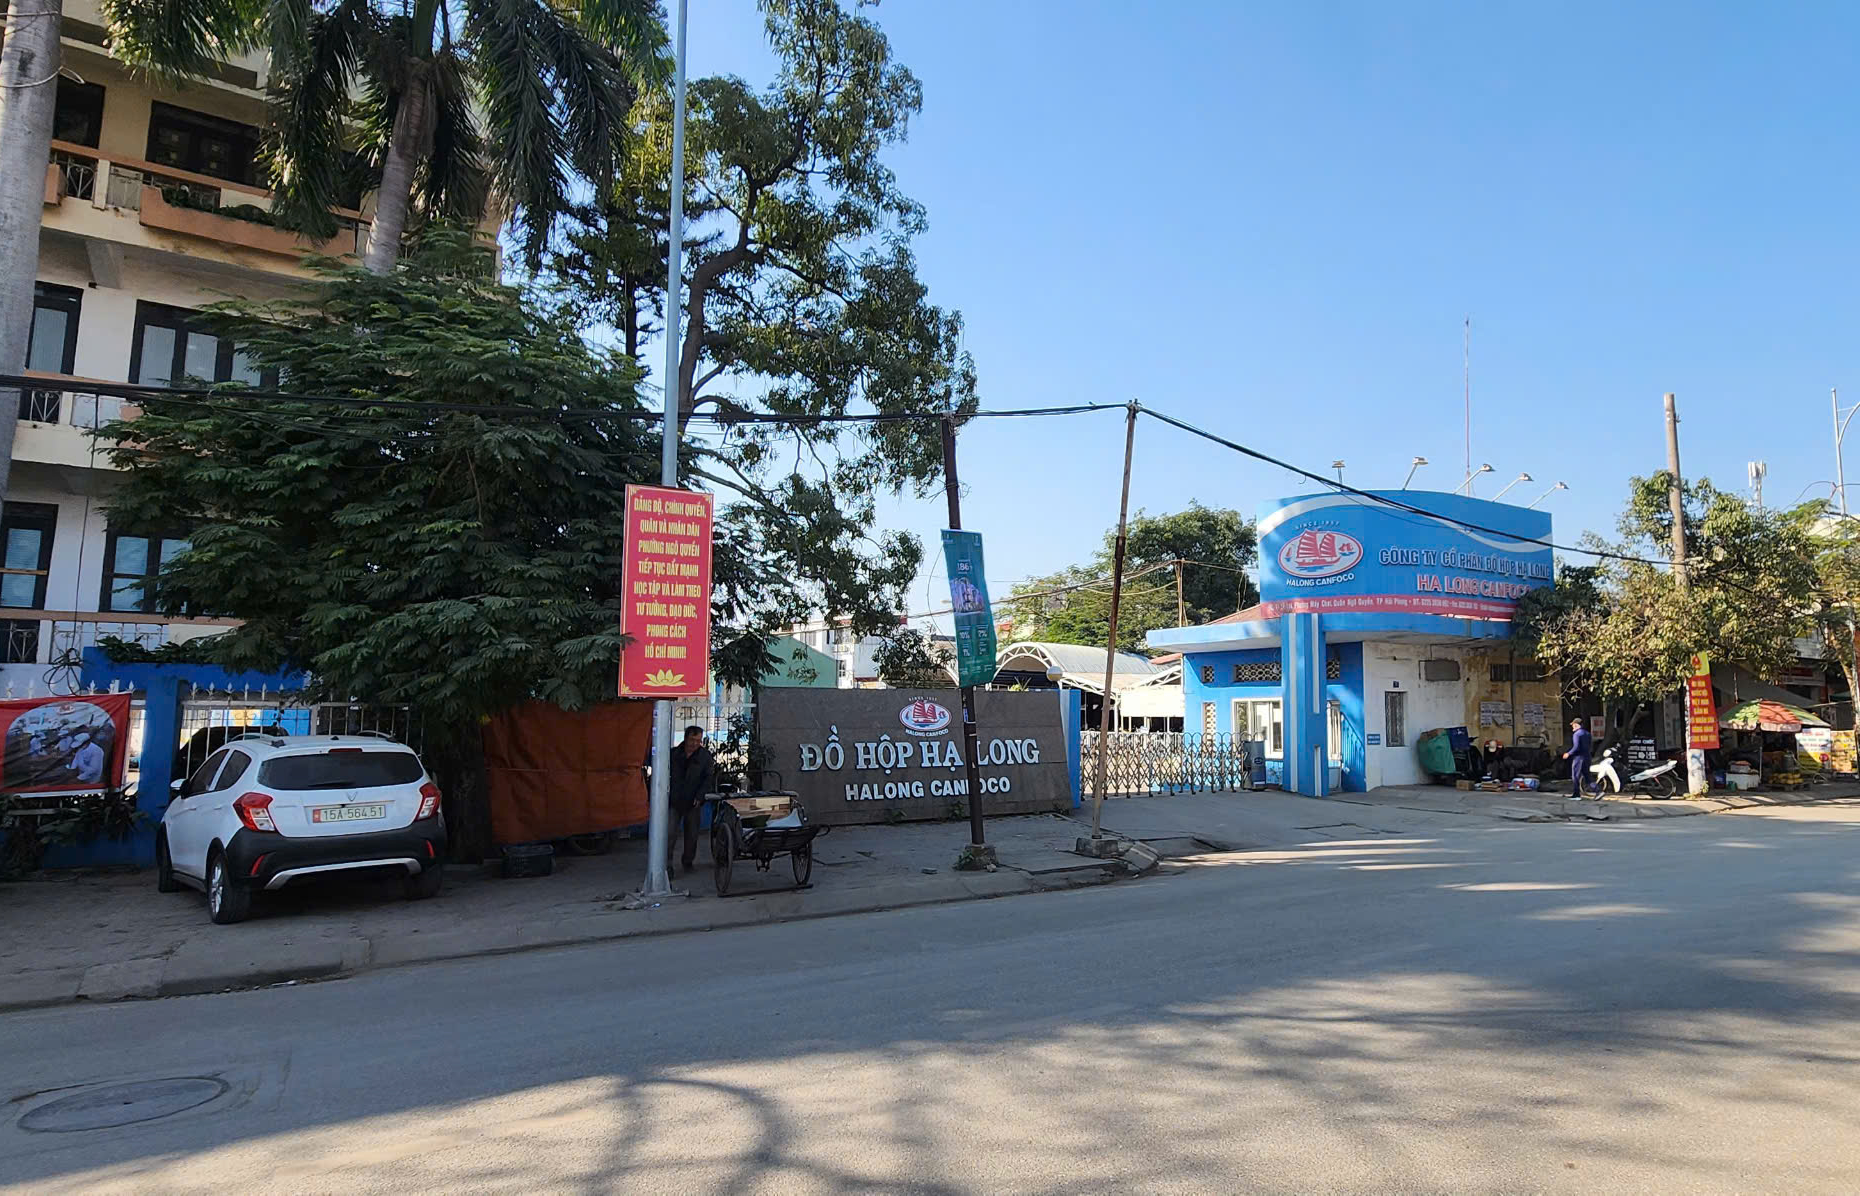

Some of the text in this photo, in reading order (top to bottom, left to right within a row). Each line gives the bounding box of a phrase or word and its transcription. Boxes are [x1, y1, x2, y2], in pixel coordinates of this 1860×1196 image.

[653, 498, 664, 516] BỘ,
[665, 500, 684, 515] CHÍNH
[685, 501, 707, 519] QUYỀN,
[640, 518, 700, 537] QUÂN VÀ NHÂN DÂN
[638, 538, 664, 555] PHƯỜNG
[680, 541, 700, 557] QUYỀN
[638, 557, 652, 574] TIẾP
[653, 561, 666, 577] TỤC
[680, 564, 699, 579] MẠNH
[1378, 545, 1420, 566] CÔNG
[1421, 549, 1439, 566] TY
[1440, 546, 1457, 567] CỔ
[1459, 550, 1483, 571] PHẦN
[1485, 553, 1498, 572] ĐỒ
[1499, 557, 1515, 578] HỘP
[634, 580, 702, 598] HỌC TẬP VÀ LÀM THEO
[1286, 573, 1355, 587] HALONG CANFOCO
[1445, 575, 1478, 595] LONG
[636, 601, 645, 616] TƯ
[646, 623, 686, 638] PHONG CÁCH
[645, 642, 687, 659] HỒ CHÍ MINH!
[799, 724, 1040, 775] ĐỒ HỘP HẠ LONG
[845, 780, 924, 801] HALONG
